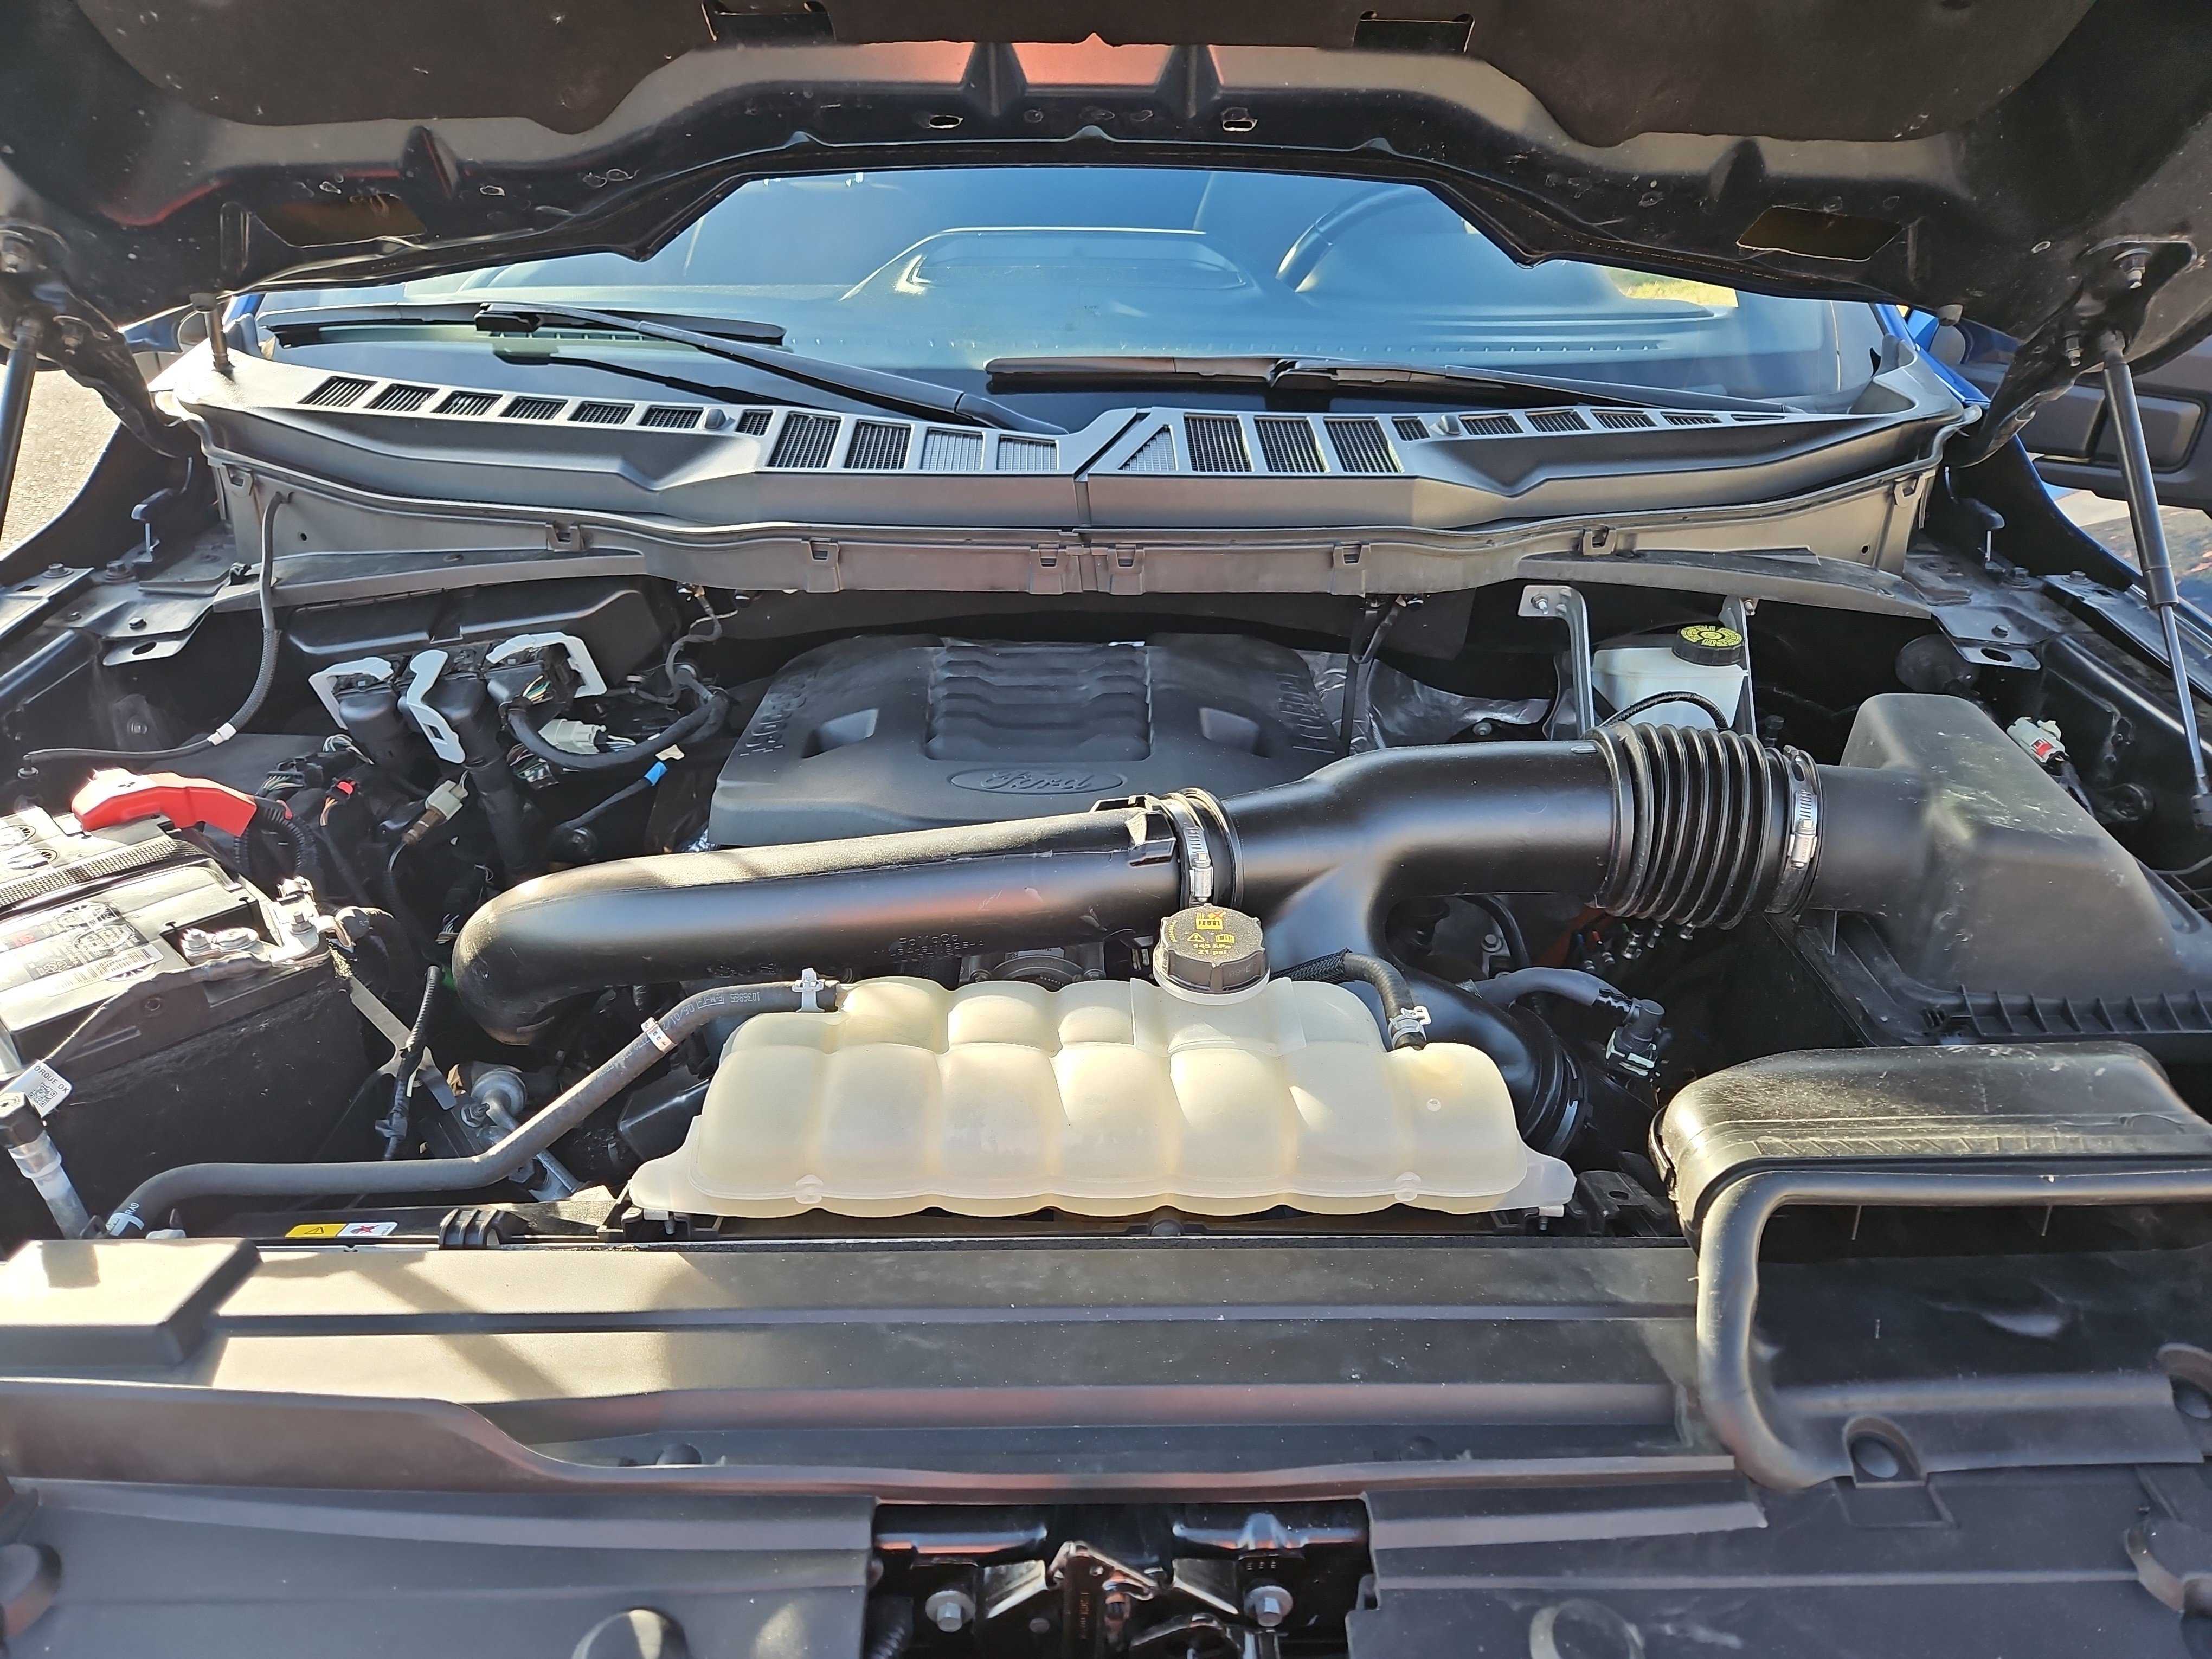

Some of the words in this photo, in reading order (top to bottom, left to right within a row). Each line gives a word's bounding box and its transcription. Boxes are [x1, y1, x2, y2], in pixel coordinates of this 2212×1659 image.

[981, 771, 1094, 790] Ford
[34, 1065, 58, 1085] ORQUE
[57, 1084, 70, 1094] OK
[124, 1202, 139, 1215] RAD
